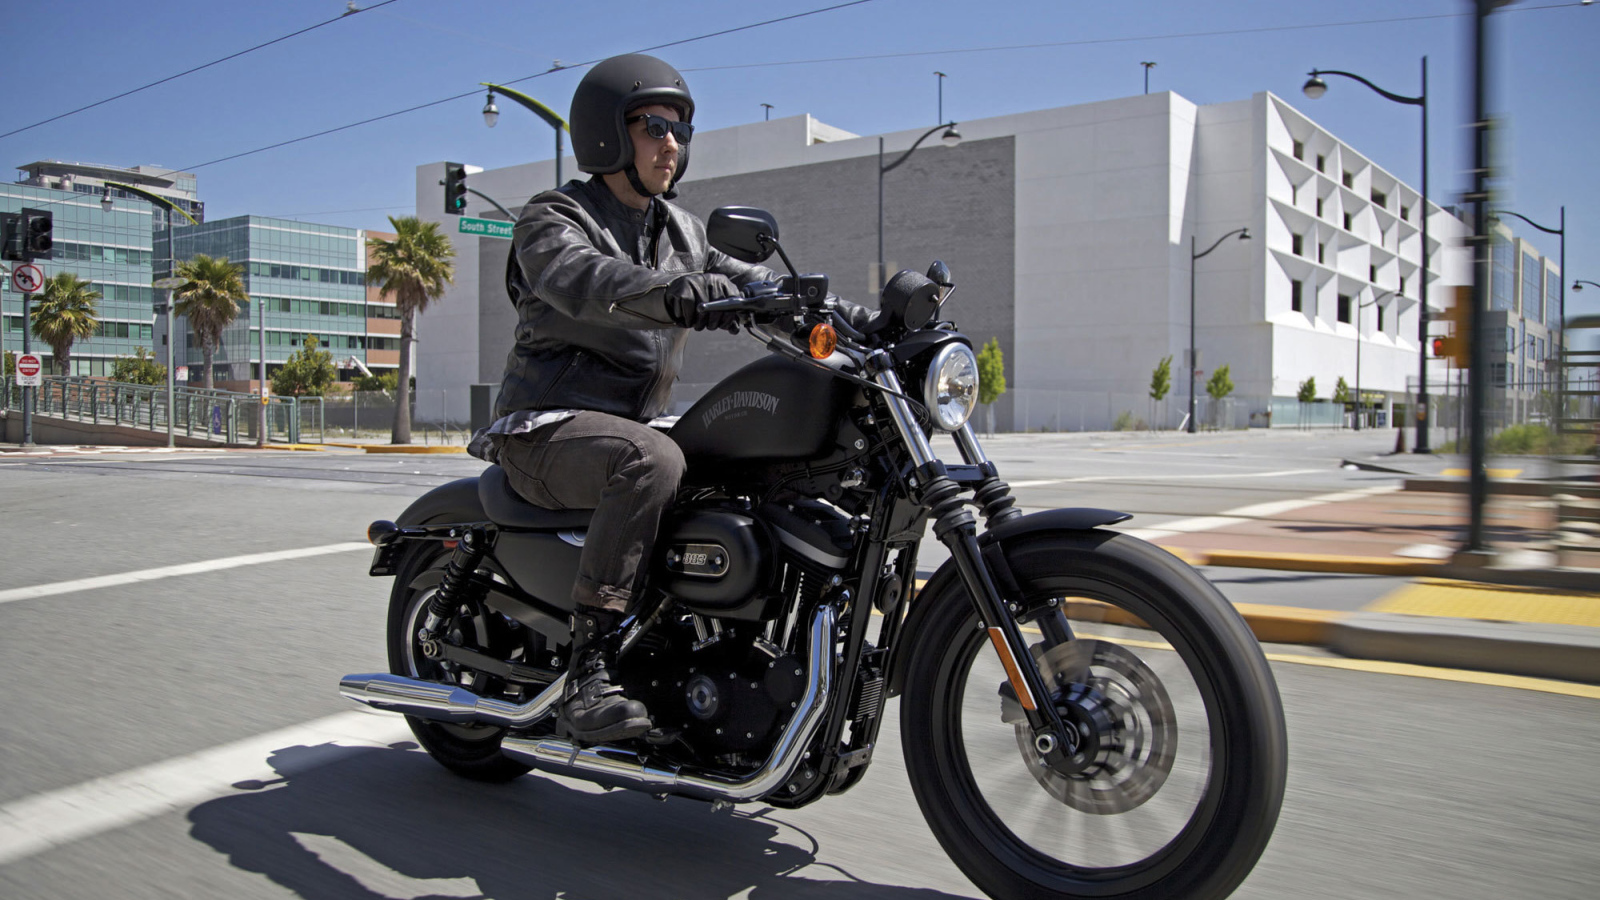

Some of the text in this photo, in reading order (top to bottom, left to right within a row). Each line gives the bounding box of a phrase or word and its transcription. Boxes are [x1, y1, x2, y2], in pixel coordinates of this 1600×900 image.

[461, 220, 513, 235] South Street
[683, 553, 707, 565] 883
